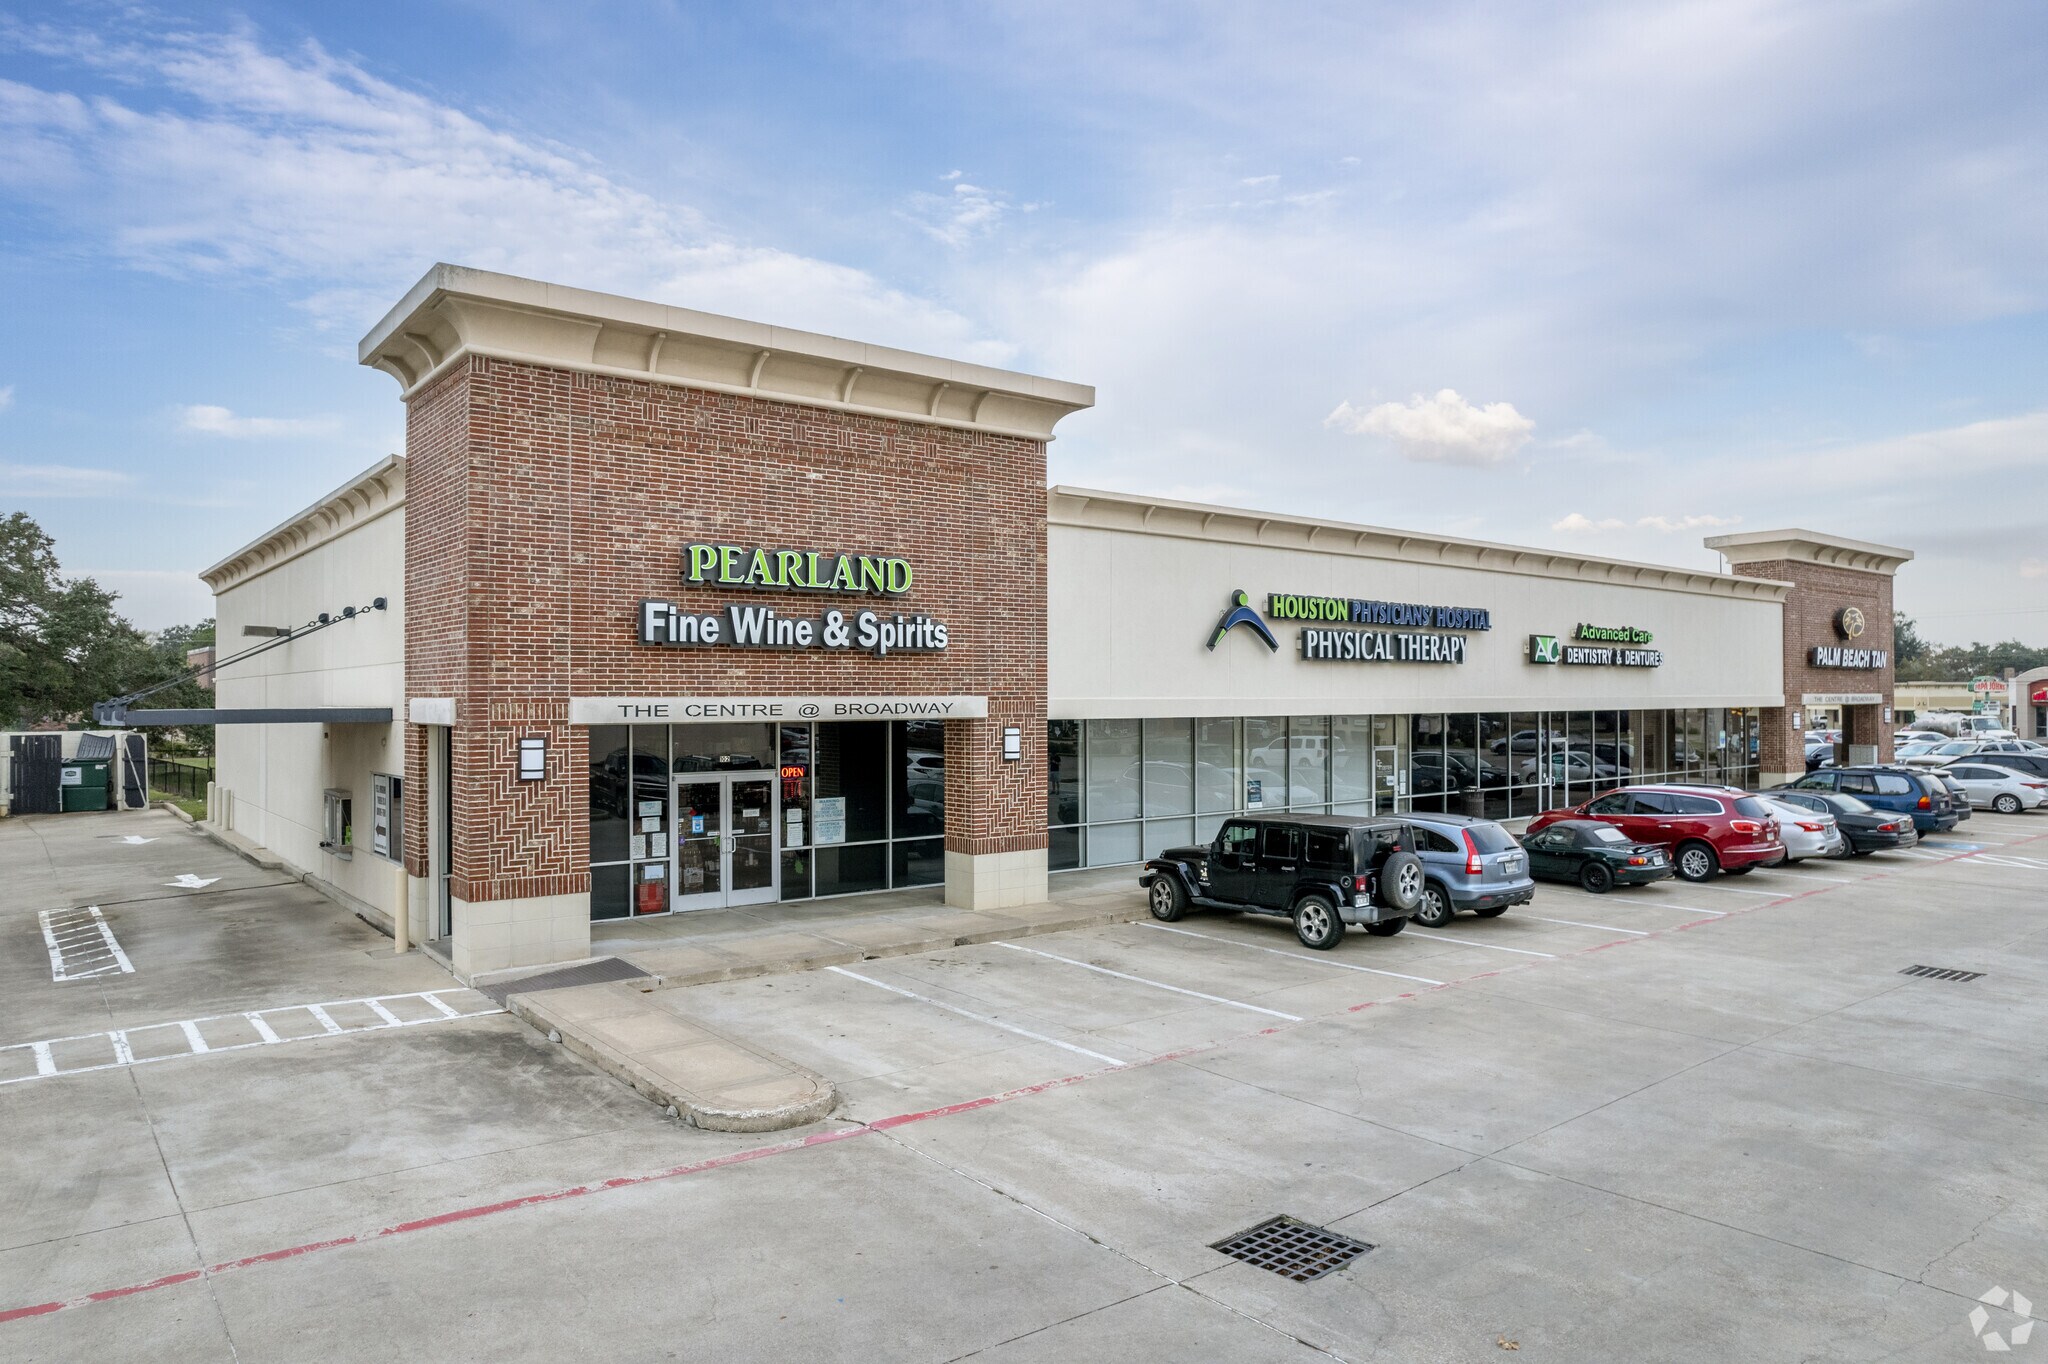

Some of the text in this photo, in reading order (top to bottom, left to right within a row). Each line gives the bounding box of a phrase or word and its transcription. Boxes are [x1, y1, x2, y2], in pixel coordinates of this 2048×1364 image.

[687, 543, 914, 594] PEARLAND
[1273, 595, 1348, 621] HOUSTON
[1436, 607, 1491, 630] HOSPITAL
[644, 602, 949, 655] Fine Wine & Spirits
[1581, 625, 1654, 643] Advanced Care
[1306, 630, 1468, 663] PHYSICAL THERAPY
[1567, 647, 1665, 666] DENTISTRY & DENTURES
[1817, 646, 1887, 668] PALM BEACH TAN
[617, 701, 954, 719] THE CENTRE @ BROADWAY
[781, 767, 804, 778] OPEN
